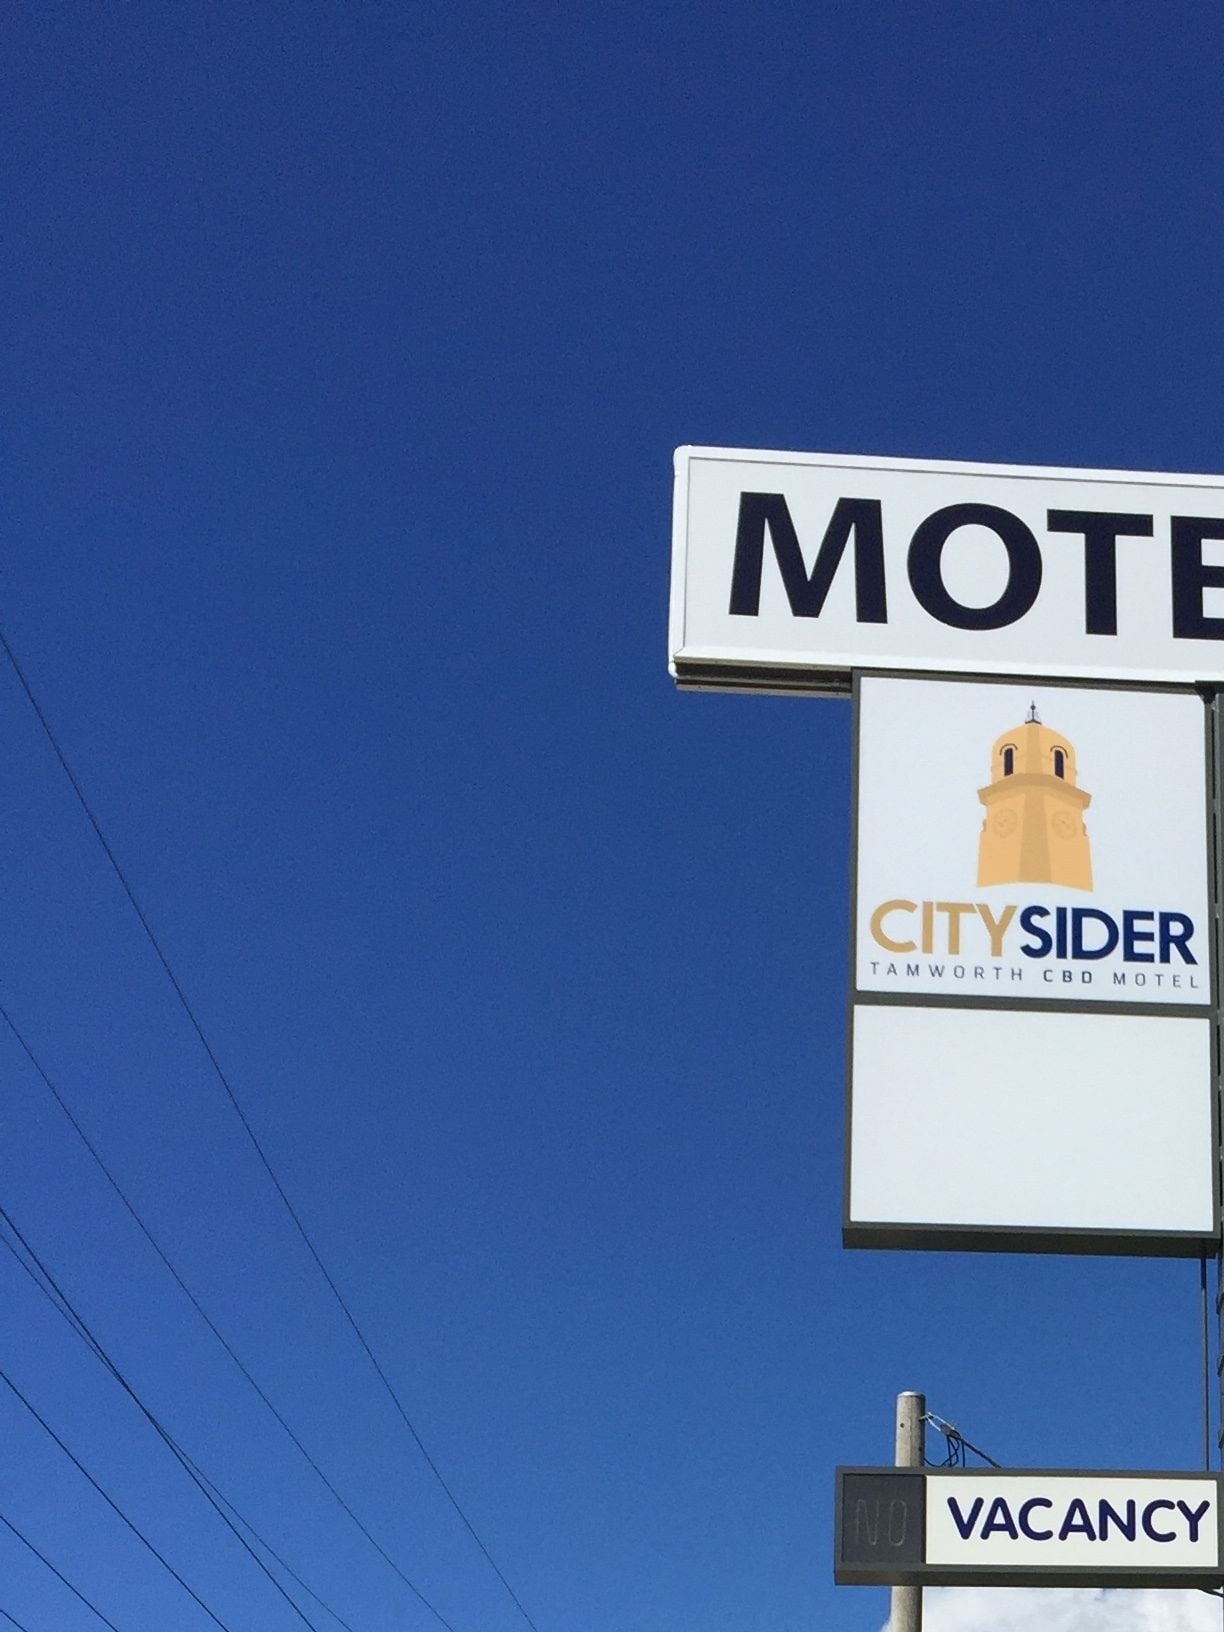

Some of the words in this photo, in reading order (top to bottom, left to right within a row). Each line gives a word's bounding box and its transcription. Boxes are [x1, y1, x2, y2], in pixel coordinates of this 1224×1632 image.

[870, 899, 1198, 965] CITYSIDER
[870, 961, 1023, 981] TAMWORTH
[1043, 969, 1093, 984] CBD
[1113, 972, 1199, 989] MOTEL
[854, 1498, 908, 1547] NO
[946, 1496, 1211, 1543] VACANCY
